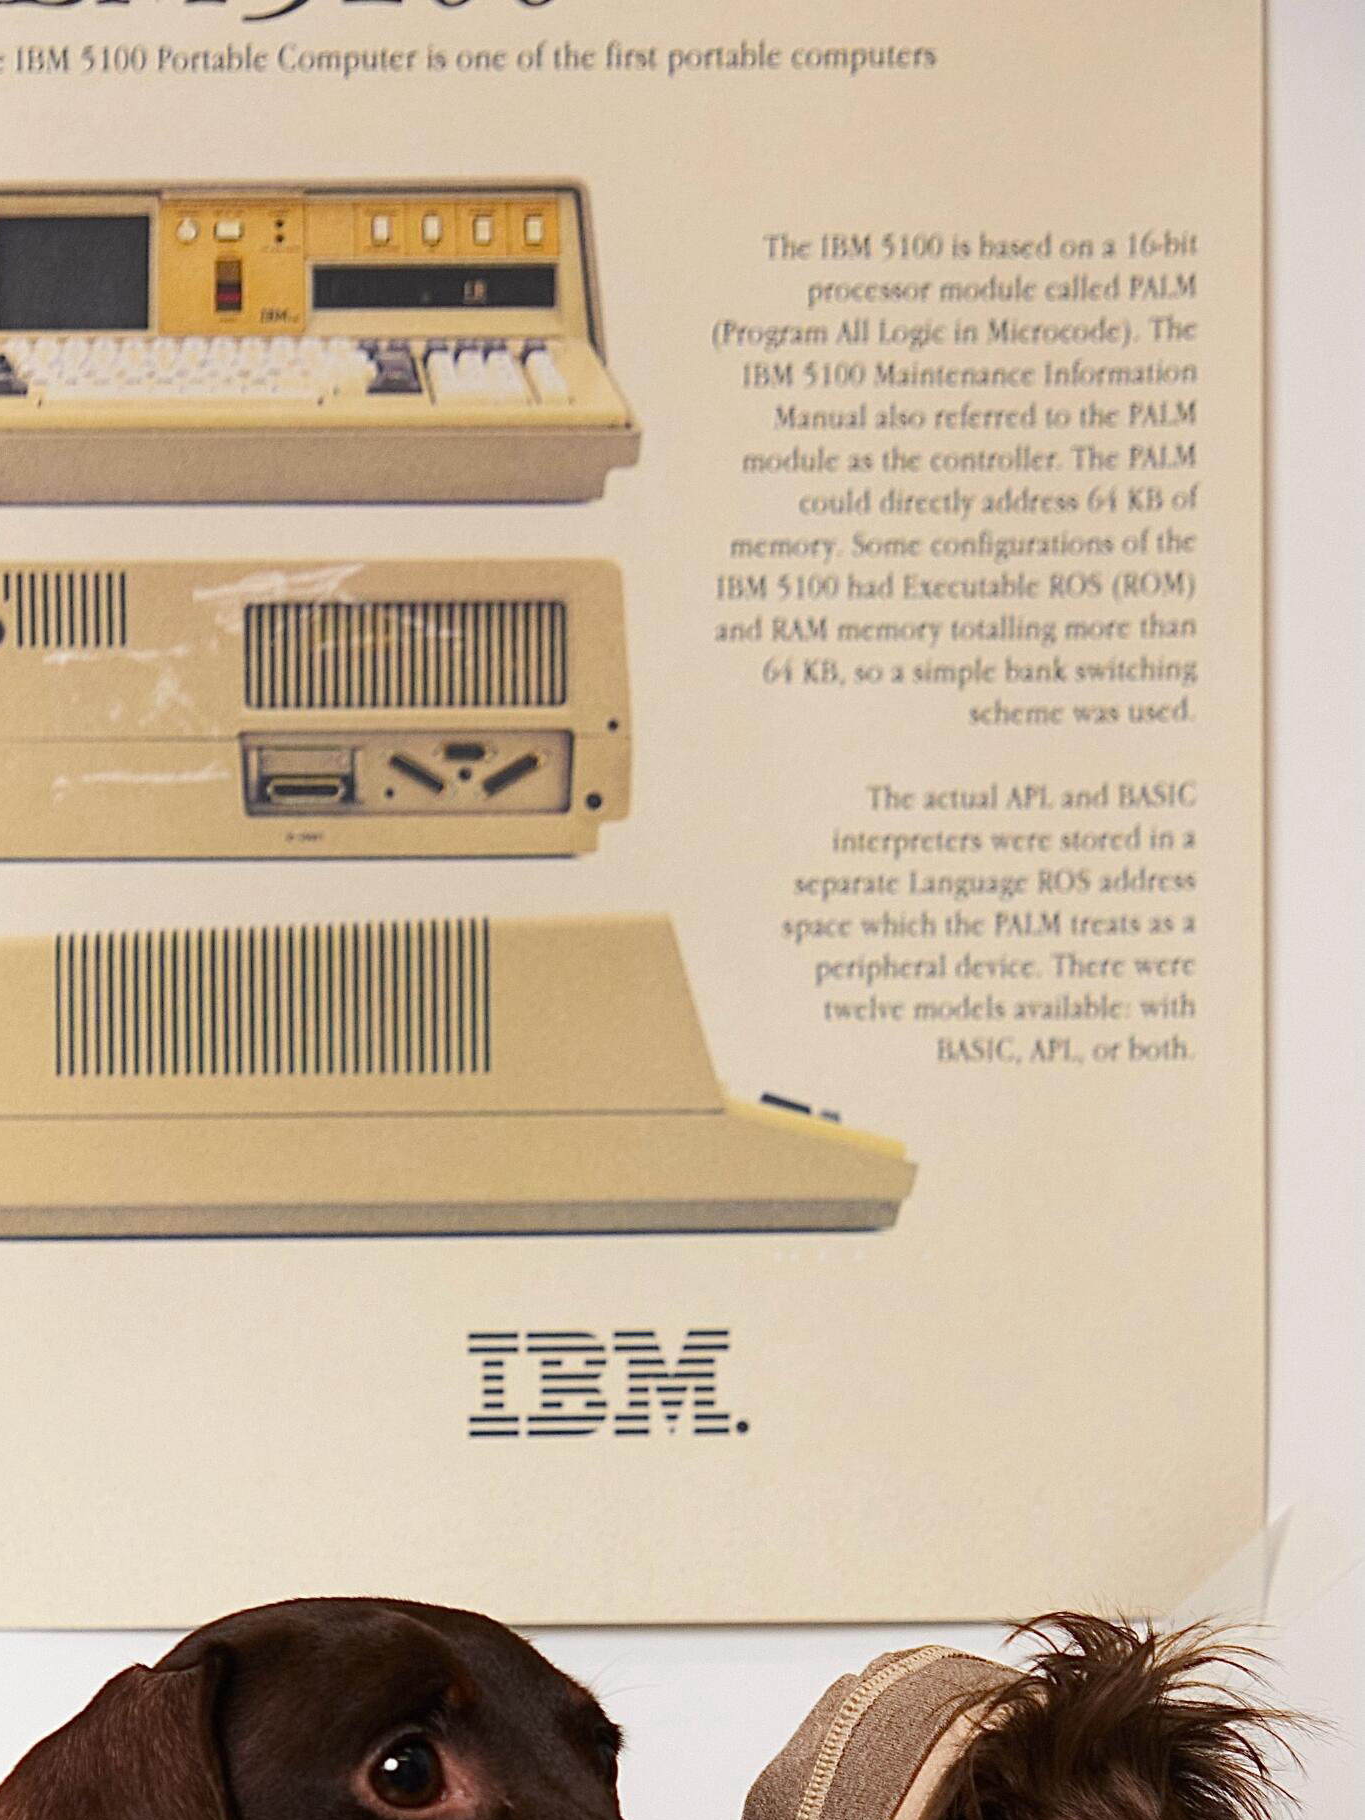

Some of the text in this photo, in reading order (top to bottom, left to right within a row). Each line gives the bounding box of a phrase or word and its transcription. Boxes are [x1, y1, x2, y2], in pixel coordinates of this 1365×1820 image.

[16, 46, 70, 73] IBM
[81, 44, 147, 74] 5100
[158, 42, 270, 73] Portable
[278, 43, 418, 79] Computer
[428, 44, 448, 71] is
[456, 50, 507, 71] one
[517, 40, 547, 71] of
[554, 41, 596, 71] the
[607, 40, 657, 71] first
[668, 39, 782, 78] portable
[792, 46, 937, 76] computers
[763, 230, 1197, 260] The IBM 5100 is based on a 16-bit
[808, 273, 1196, 310] processor module called PALM
[713, 315, 1197, 353] (Program All Logic in Microcode). The
[744, 358, 1197, 389] IBM 5100 Maintenance Information
[775, 399, 1196, 430] Manual also referred to the PALM
[743, 443, 1196, 473] module as the controller. The PALM
[799, 484, 1199, 521] could directly address 64 KB of
[731, 527, 1196, 565] memory. Some configurations of the
[717, 570, 1195, 604] IBM 5100 had Executable ROS (ROM)
[715, 611, 1196, 647] and RAM memory totalling more than
[763, 655, 1197, 691] 64 KB, so a simple bank switching
[969, 696, 1194, 725] scheme was used.
[867, 781, 1196, 810] The actual APL and BASIC
[833, 823, 1195, 860] interpreters were stored in a
[795, 866, 1196, 902] separate Language ROS address
[782, 910, 1195, 945] space which the PALM treats as a
[816, 951, 1195, 987] peripheral device. There were
[825, 992, 1195, 1021] twelve models available: with
[938, 1034, 1194, 1065] BASIC, APL, or both.
